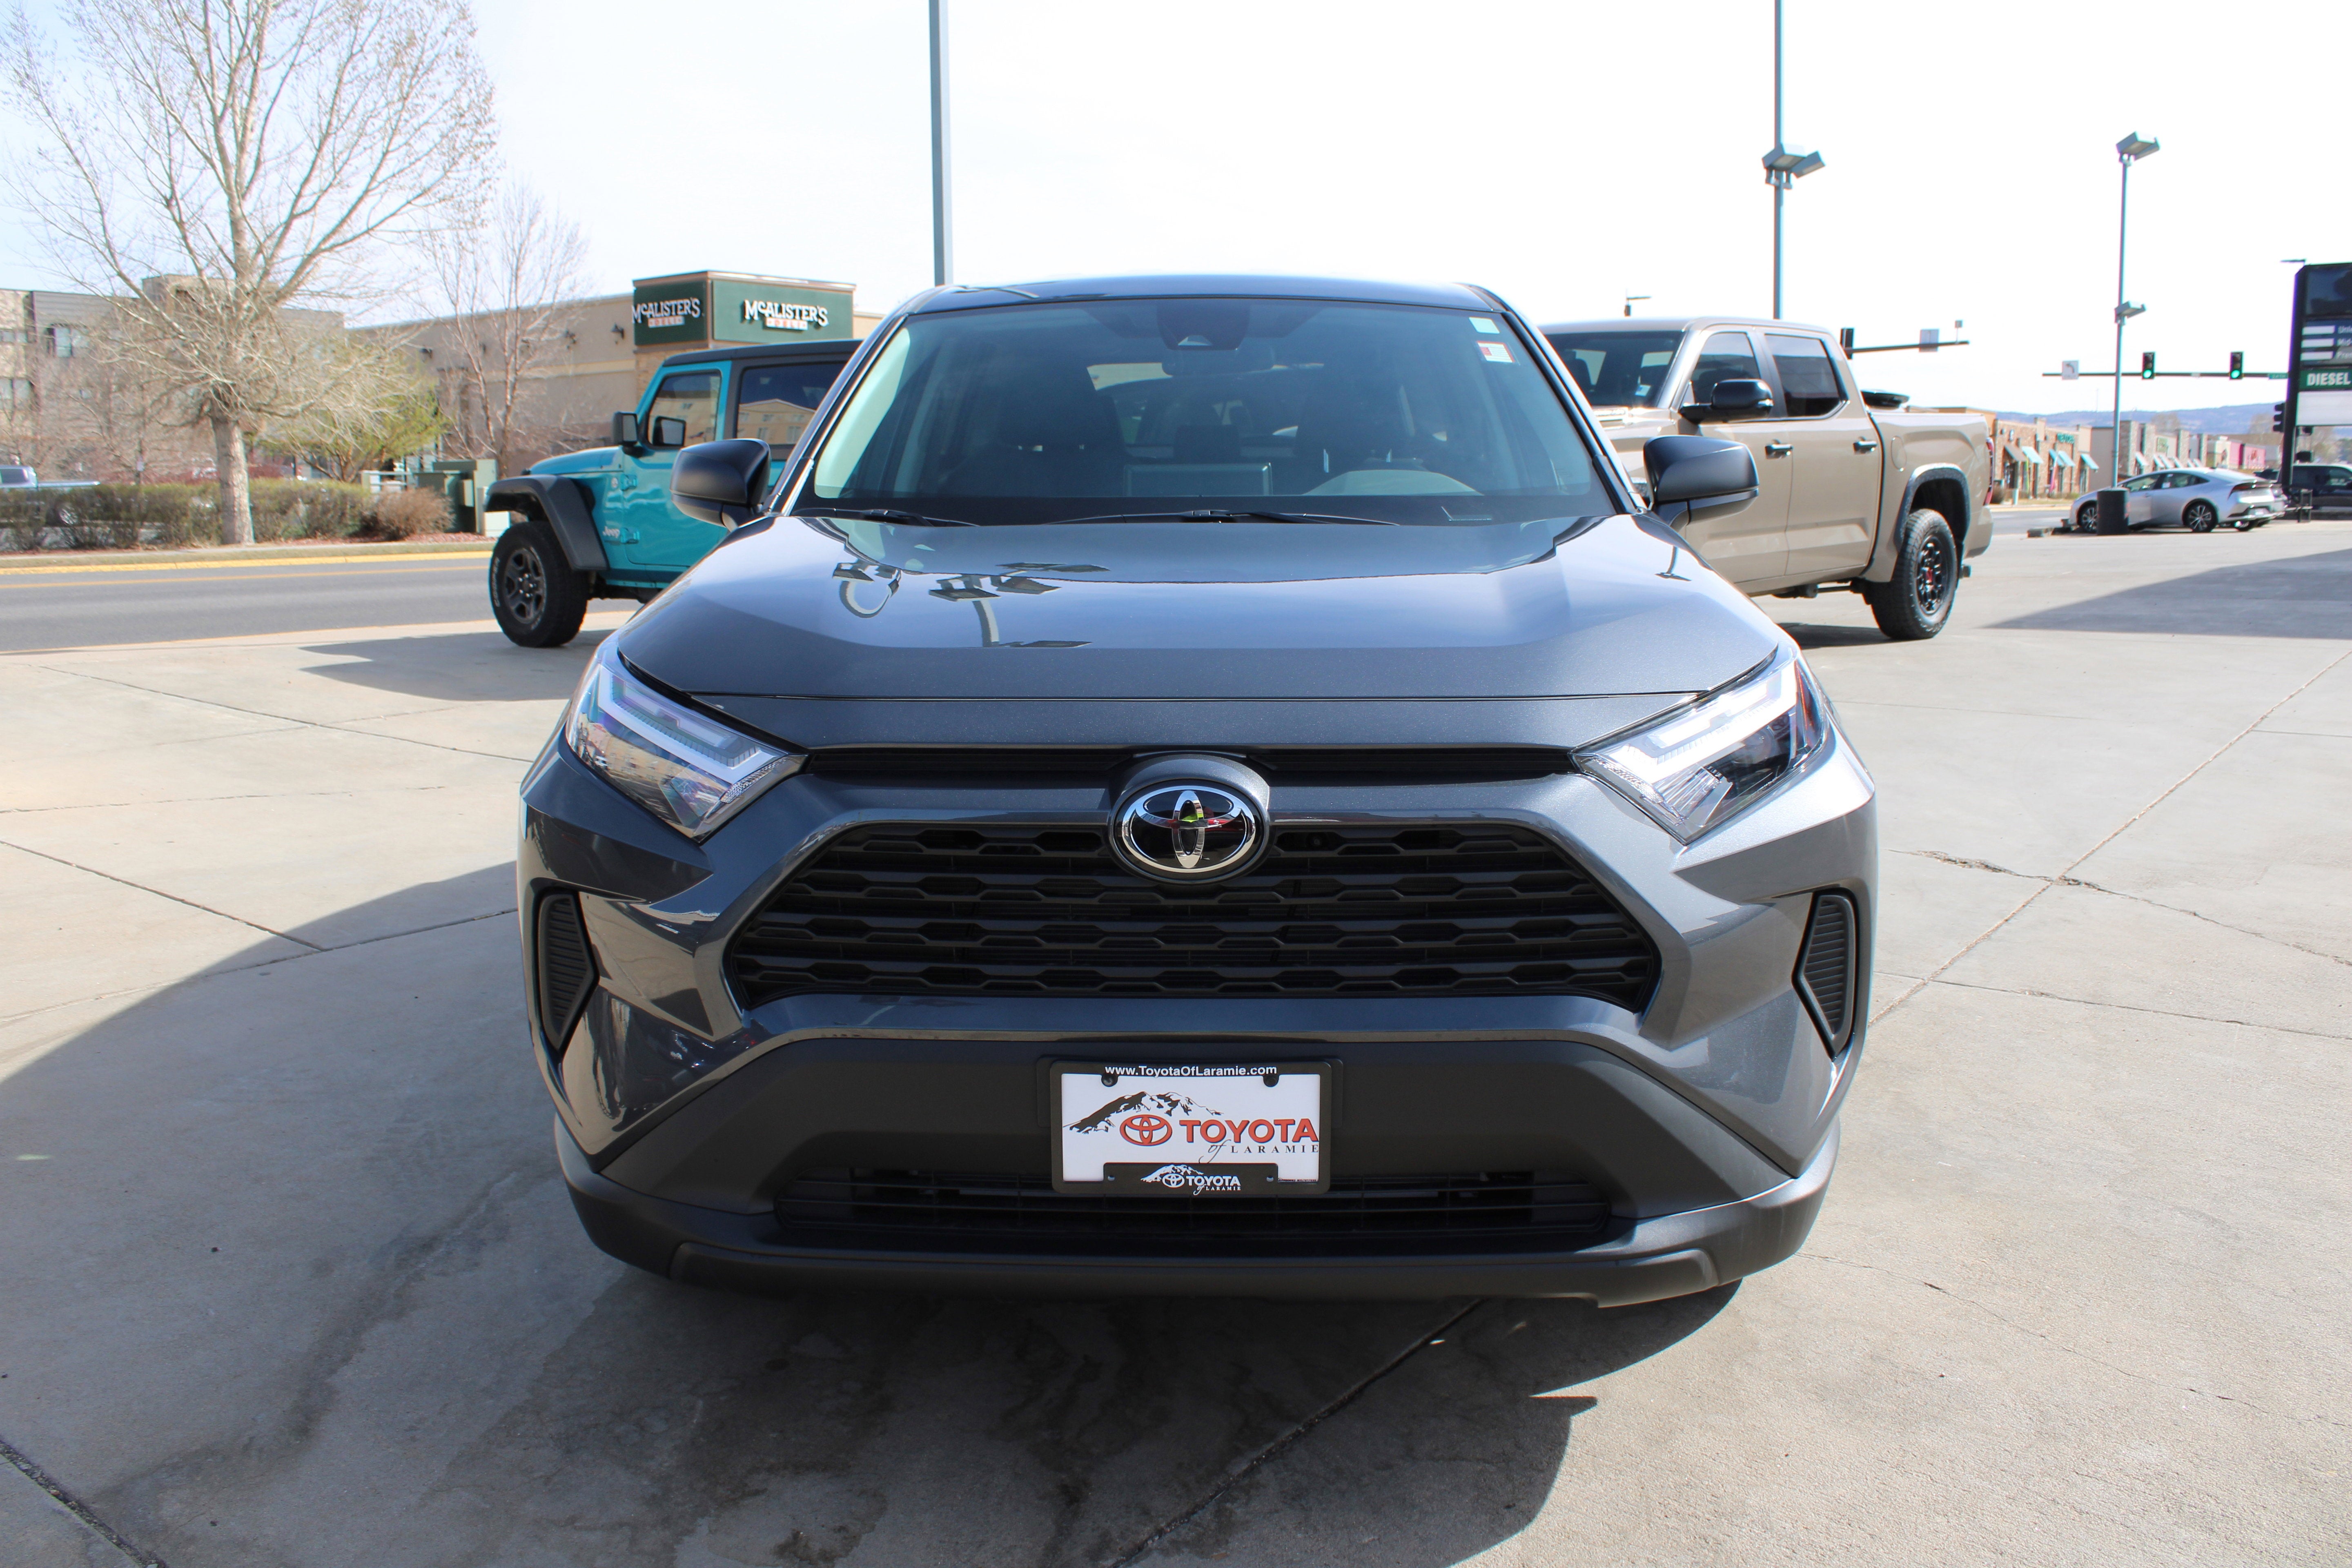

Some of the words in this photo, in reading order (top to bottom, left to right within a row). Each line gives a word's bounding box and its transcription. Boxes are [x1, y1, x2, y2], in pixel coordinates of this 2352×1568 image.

[2307, 372, 2351, 386] DIESEL
[1105, 1065, 1277, 1078] www.ToyotaOfLaramie.com
[1179, 1118, 1319, 1143] TOYOTA
[1230, 1145, 1319, 1154] LARAMIE
[1186, 1176, 1241, 1186] TOYOTA
